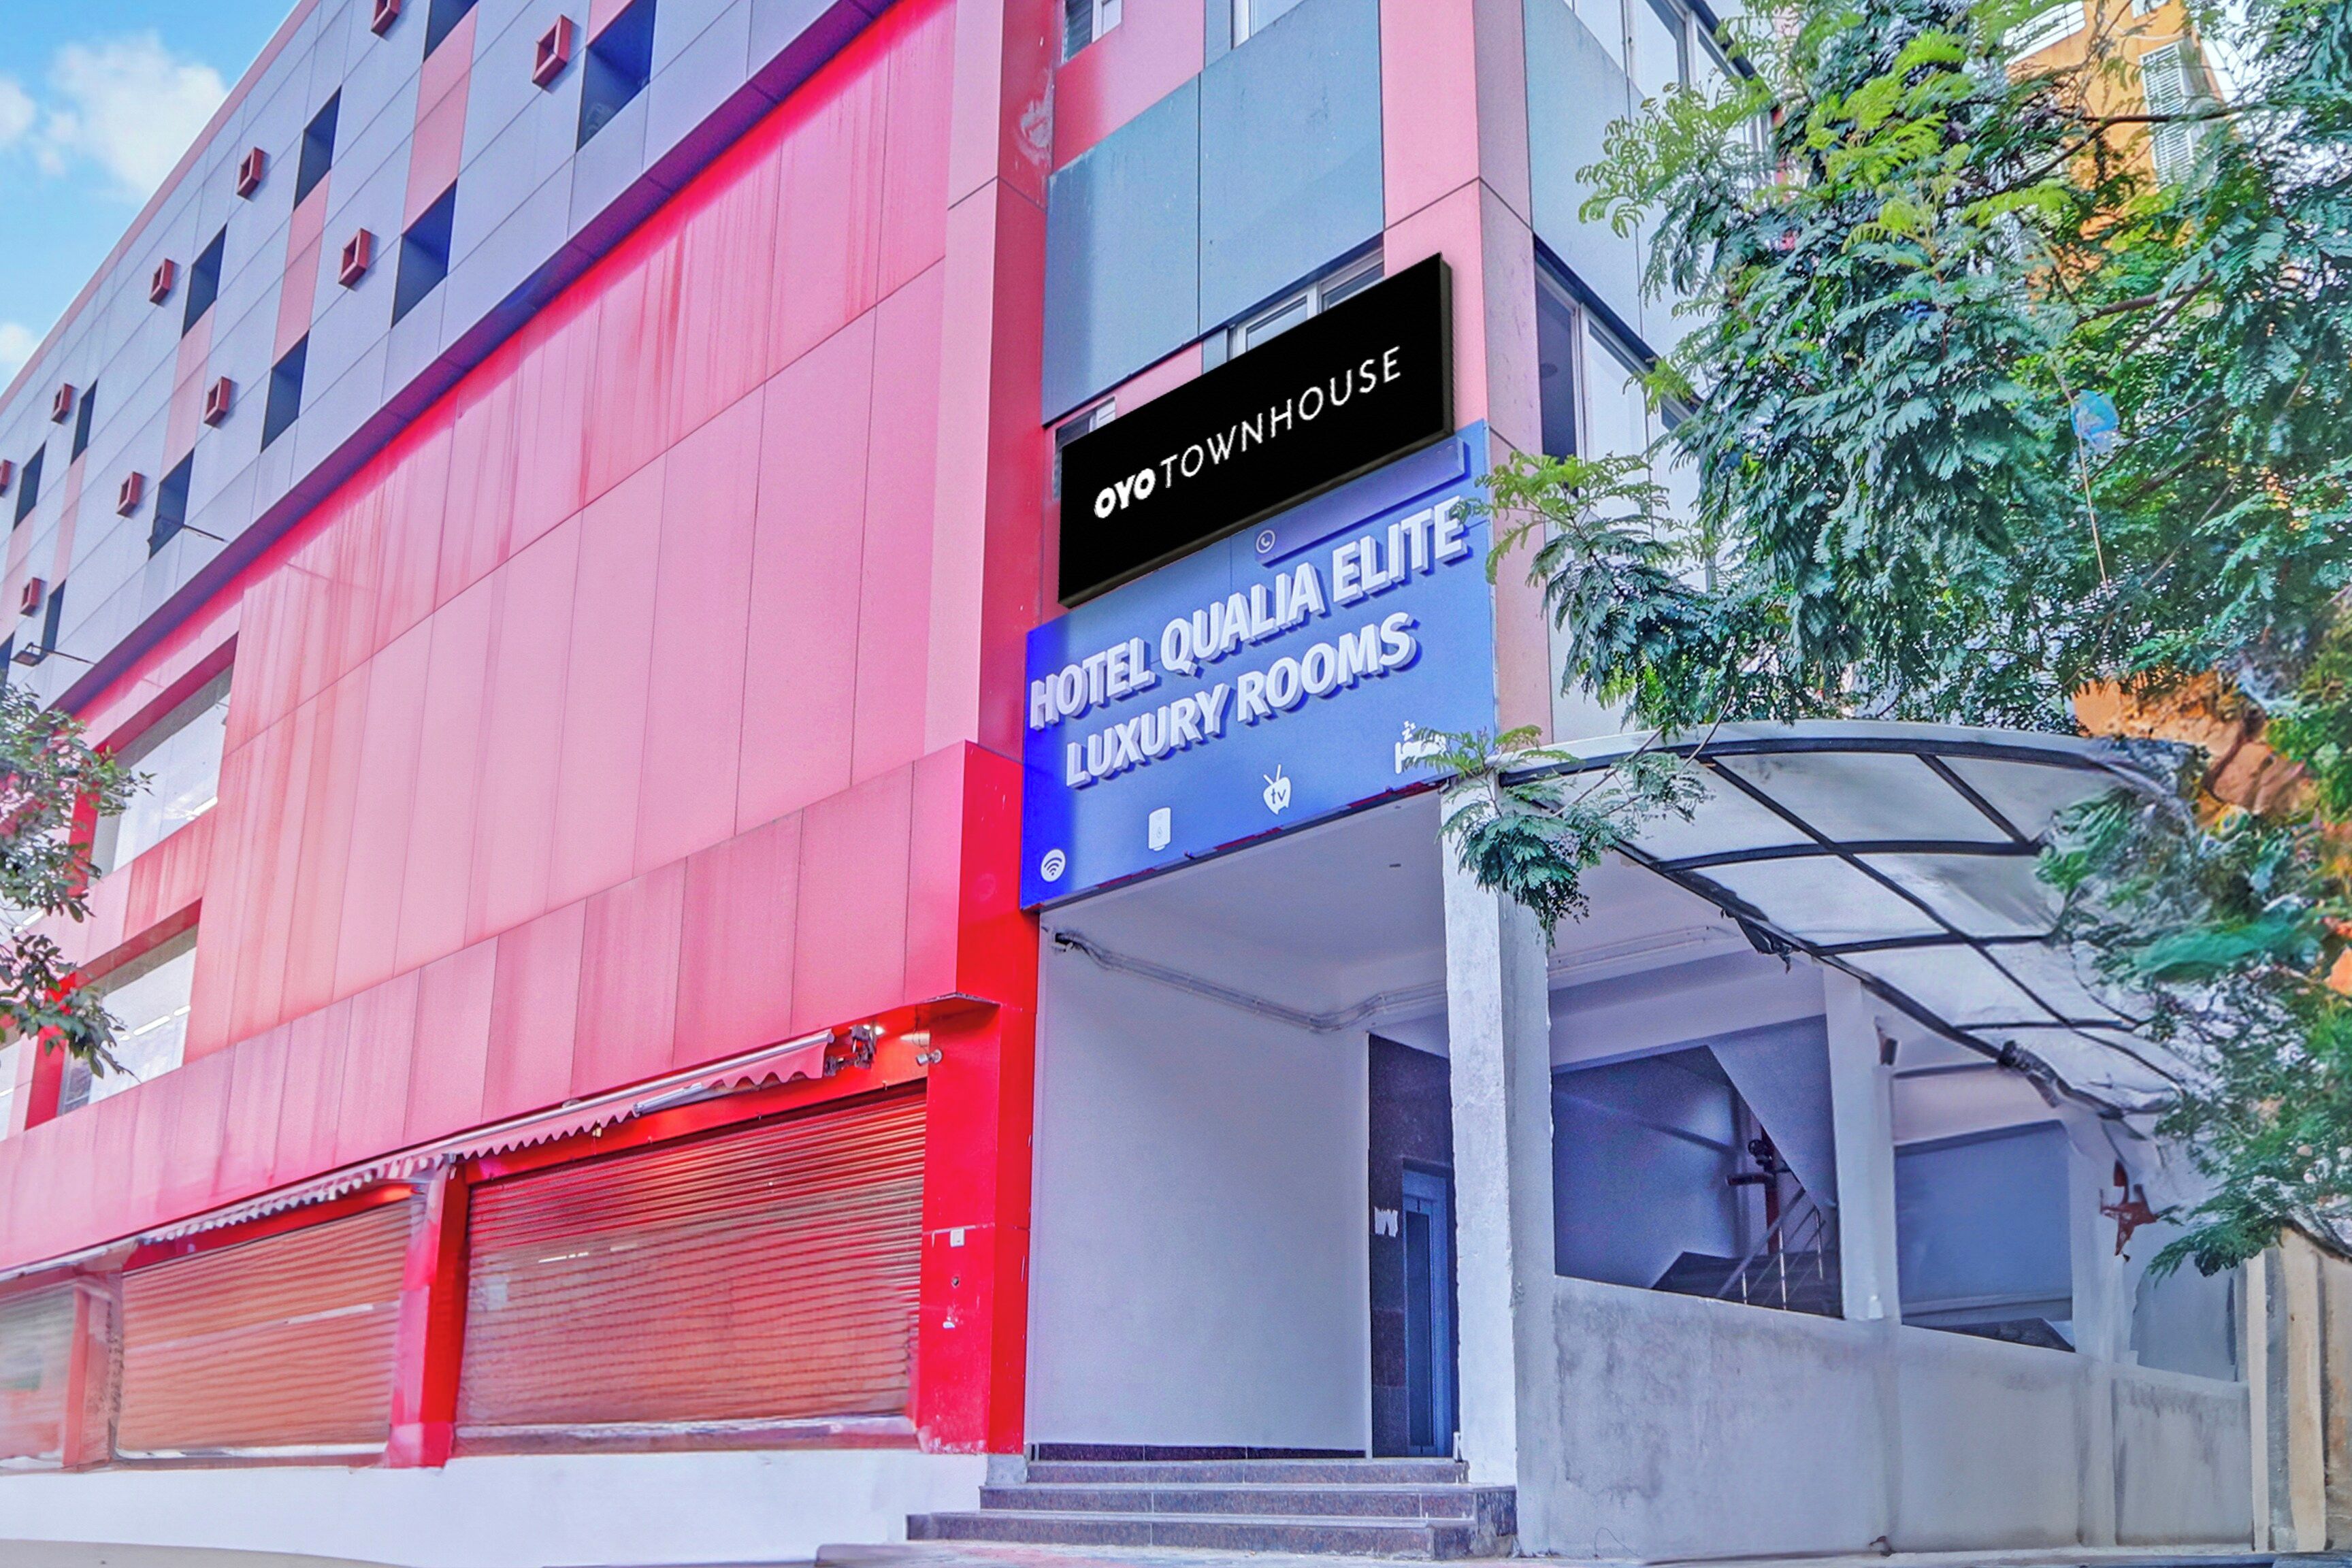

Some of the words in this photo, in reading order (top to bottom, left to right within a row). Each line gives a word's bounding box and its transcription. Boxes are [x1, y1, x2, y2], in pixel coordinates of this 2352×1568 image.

[1093, 468, 1156, 519] OYO
[1160, 346, 1401, 489] TOWNHOUSE
[1029, 637, 1156, 731] HOTEL
[1160, 562, 1326, 676] QUALIA
[1333, 495, 1470, 606] ELITE
[1066, 683, 1230, 788] LUXURY
[1237, 612, 1418, 725] ROOMS
[1271, 787, 1286, 804] tv
